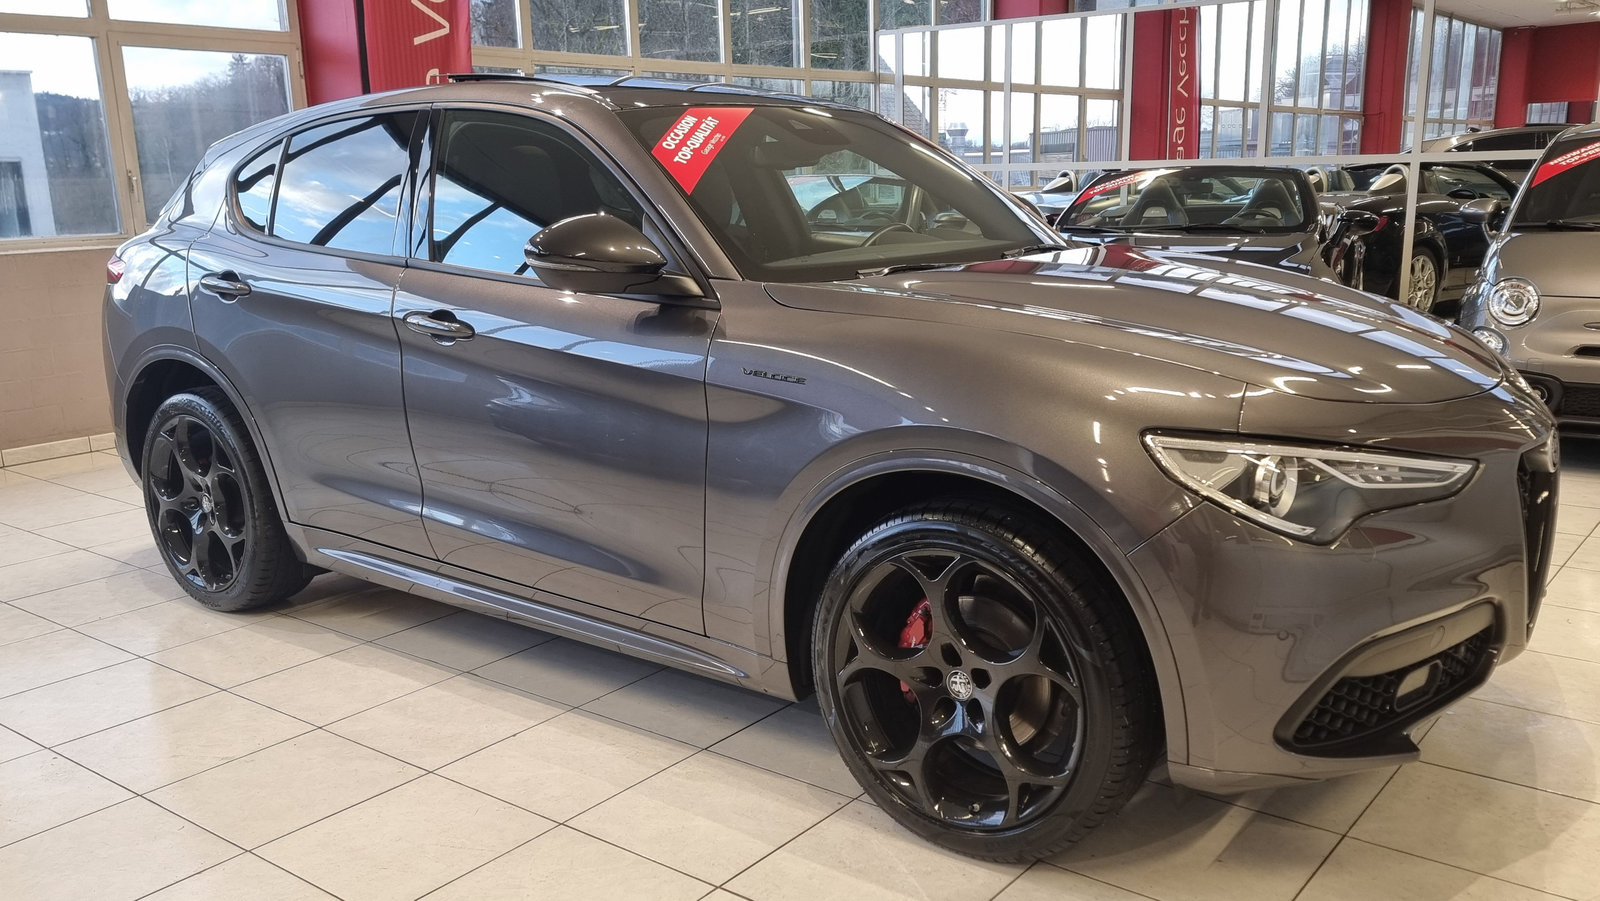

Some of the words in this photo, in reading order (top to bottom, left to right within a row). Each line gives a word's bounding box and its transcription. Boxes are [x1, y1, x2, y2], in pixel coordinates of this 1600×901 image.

[411, 0, 450, 45] V
[662, 115, 698, 149] OCCASION
[673, 115, 720, 164] TOP-QUALITÄT
[741, 367, 807, 385] VELOCE
